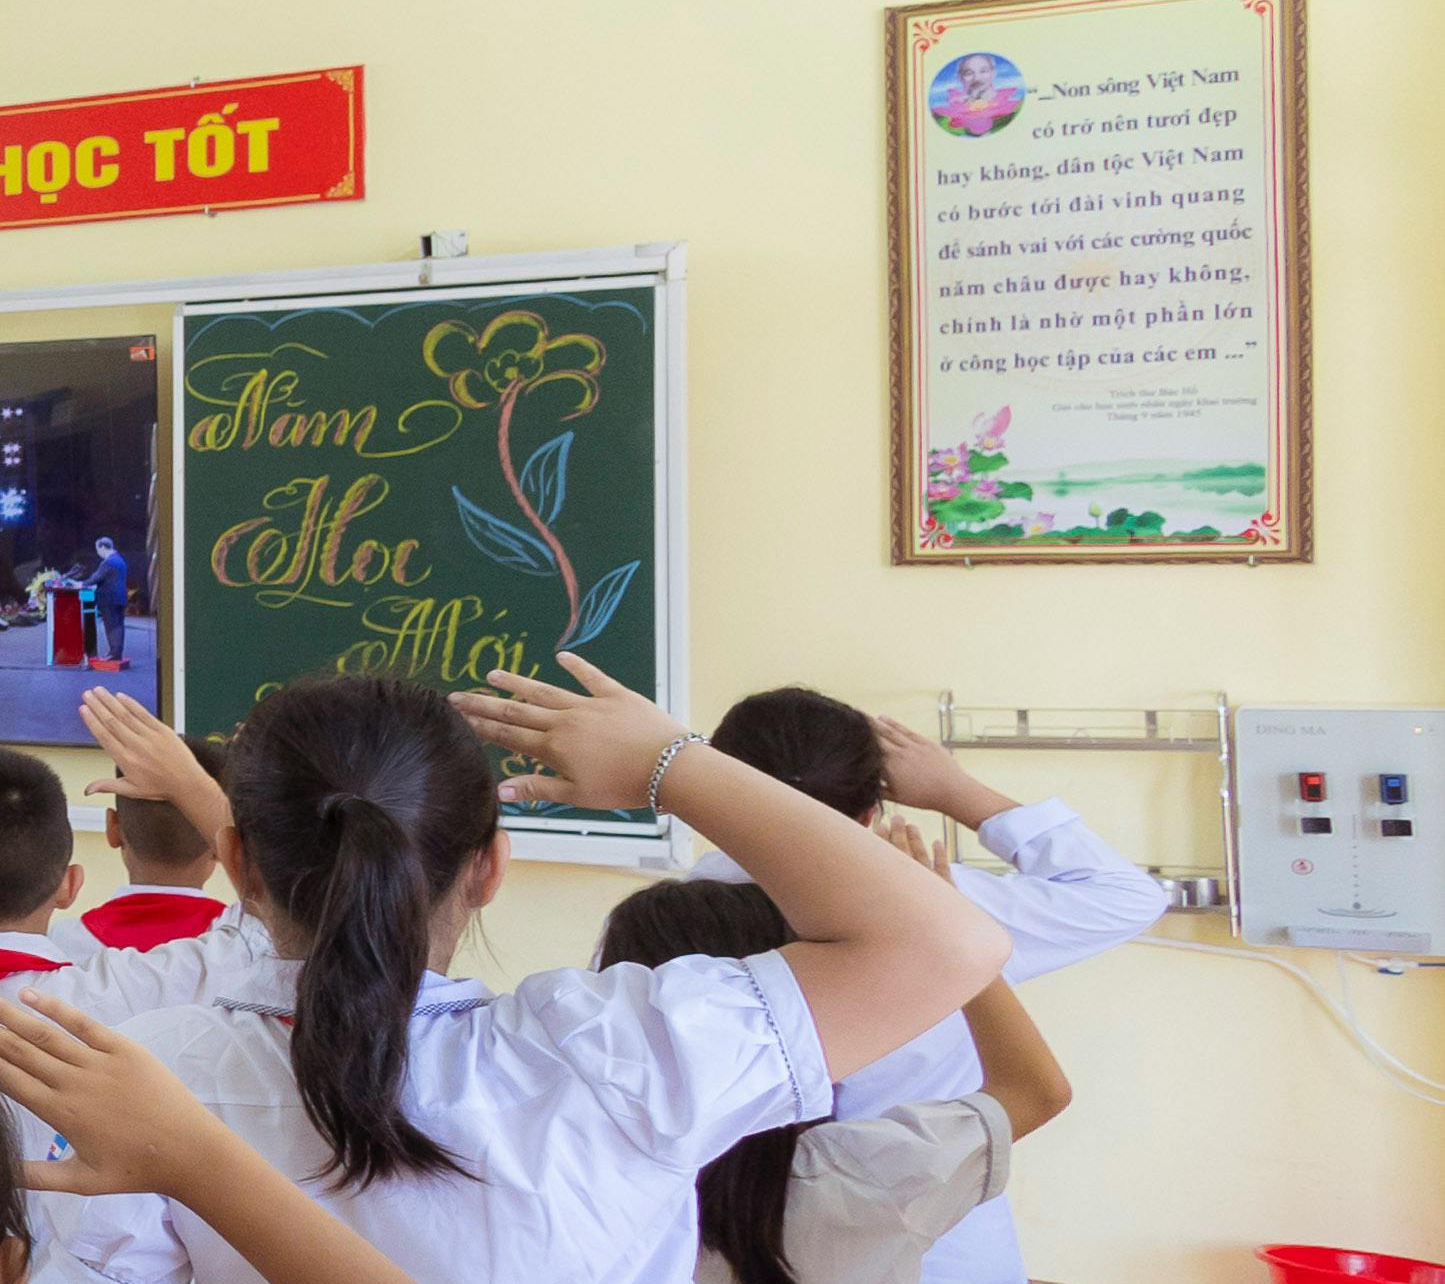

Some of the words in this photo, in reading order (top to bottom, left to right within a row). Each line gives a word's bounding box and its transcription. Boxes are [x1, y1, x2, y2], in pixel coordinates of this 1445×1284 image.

[1097, 77, 1140, 97] sông
[1147, 69, 1184, 90] Việt
[1191, 68, 1239, 85] Nam
[1032, 125, 1054, 139] có
[1062, 120, 1094, 137] trở
[1101, 116, 1138, 133] nên
[1147, 108, 1190, 128] tươi
[1199, 106, 1237, 125] đẹp
[145, 102, 280, 183] TỐT
[937, 169, 971, 188] hay
[1057, 159, 1095, 176] dân
[1104, 153, 1134, 173] tộc
[1142, 148, 1184, 170] Việt
[1192, 146, 1244, 163] Nam
[938, 207, 960, 223] có
[968, 202, 1022, 220] bước
[1032, 197, 1061, 215] tới
[1069, 194, 1104, 212] đài
[1113, 191, 1163, 209] vinh
[1171, 186, 1245, 205] quang
[967, 235, 1012, 258] sánh
[1018, 234, 1048, 254] vai
[1054, 231, 1085, 252] với
[1091, 231, 1123, 249] các
[1130, 225, 1195, 248] cường
[1202, 218, 1252, 242] quốc
[939, 279, 985, 298] năm
[993, 274, 1046, 295] châu
[1054, 273, 1111, 293] được
[1120, 270, 1160, 290] hay
[939, 316, 1002, 336] chính
[1010, 314, 1030, 331] là
[1039, 311, 1084, 330] nhờ
[1092, 308, 1136, 330] một
[1145, 300, 1205, 329] phần
[1214, 302, 1253, 322] lớn
[959, 353, 1007, 374] công
[1014, 351, 1050, 373] học
[1057, 346, 1091, 371] tập
[1098, 347, 1135, 366] của
[1142, 345, 1177, 364] các
[1184, 348, 1217, 361] em
[211, 473, 433, 609] Học
[338, 595, 539, 684] Mới
